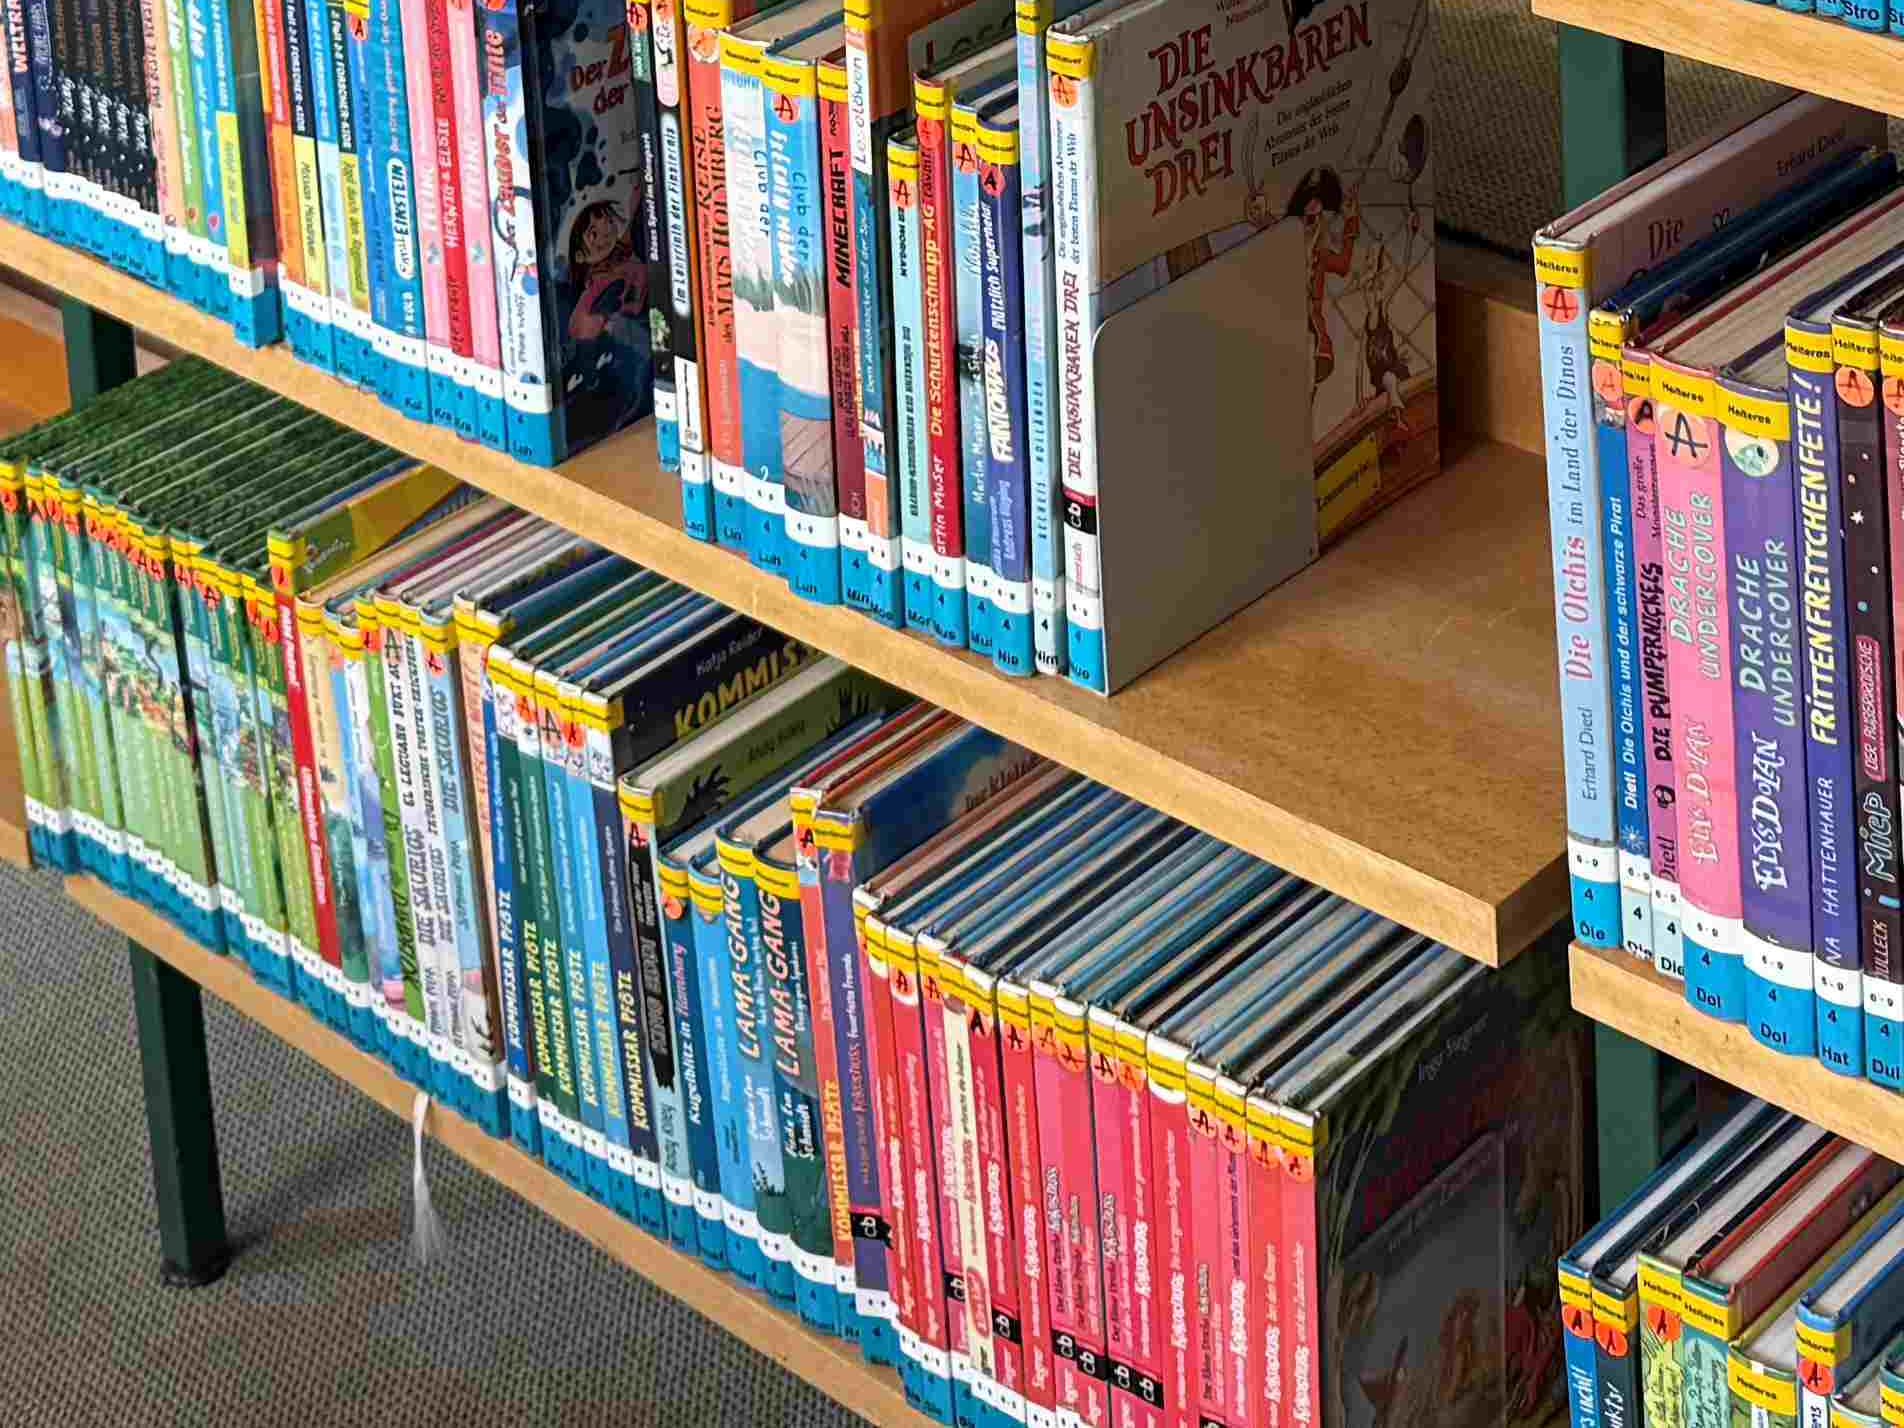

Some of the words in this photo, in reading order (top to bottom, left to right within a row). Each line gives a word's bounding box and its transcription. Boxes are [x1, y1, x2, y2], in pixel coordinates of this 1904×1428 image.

[1125, 0, 1374, 168] UNSINKBAREN
[1149, 22, 1218, 96] DIE
[1144, 128, 1236, 217] DREI
[1738, 553, 1766, 692] DRACHE
[1769, 538, 1797, 728] UNDERCOVER
